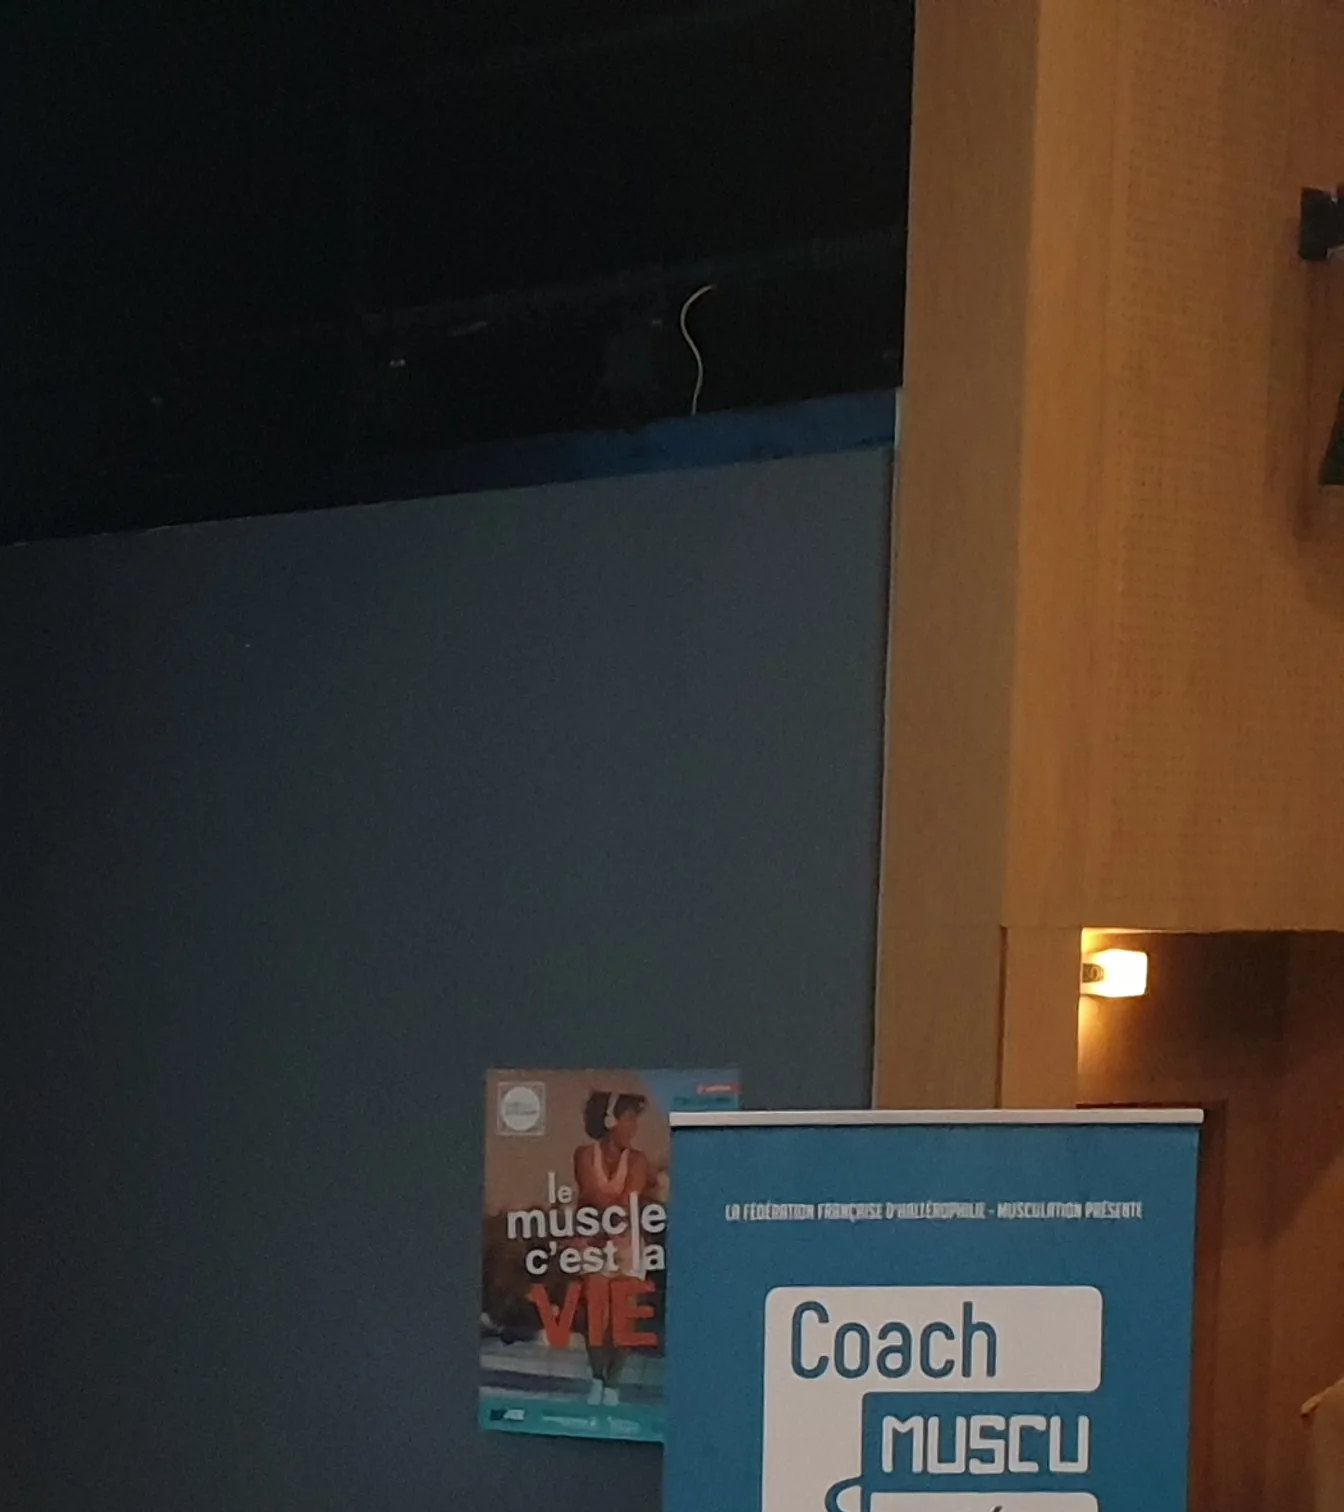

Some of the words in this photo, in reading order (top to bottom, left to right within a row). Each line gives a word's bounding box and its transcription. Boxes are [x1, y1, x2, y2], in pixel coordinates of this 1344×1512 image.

[548, 1172, 572, 1204] le
[725, 1203, 740, 1221] LA
[507, 1192, 667, 1240] muscle
[525, 1241, 618, 1276] c'est
[631, 1240, 666, 1279] la
[529, 1278, 658, 1348] VIE
[789, 1301, 998, 1380] Coach
[881, 1414, 1090, 1475] MUSCU
